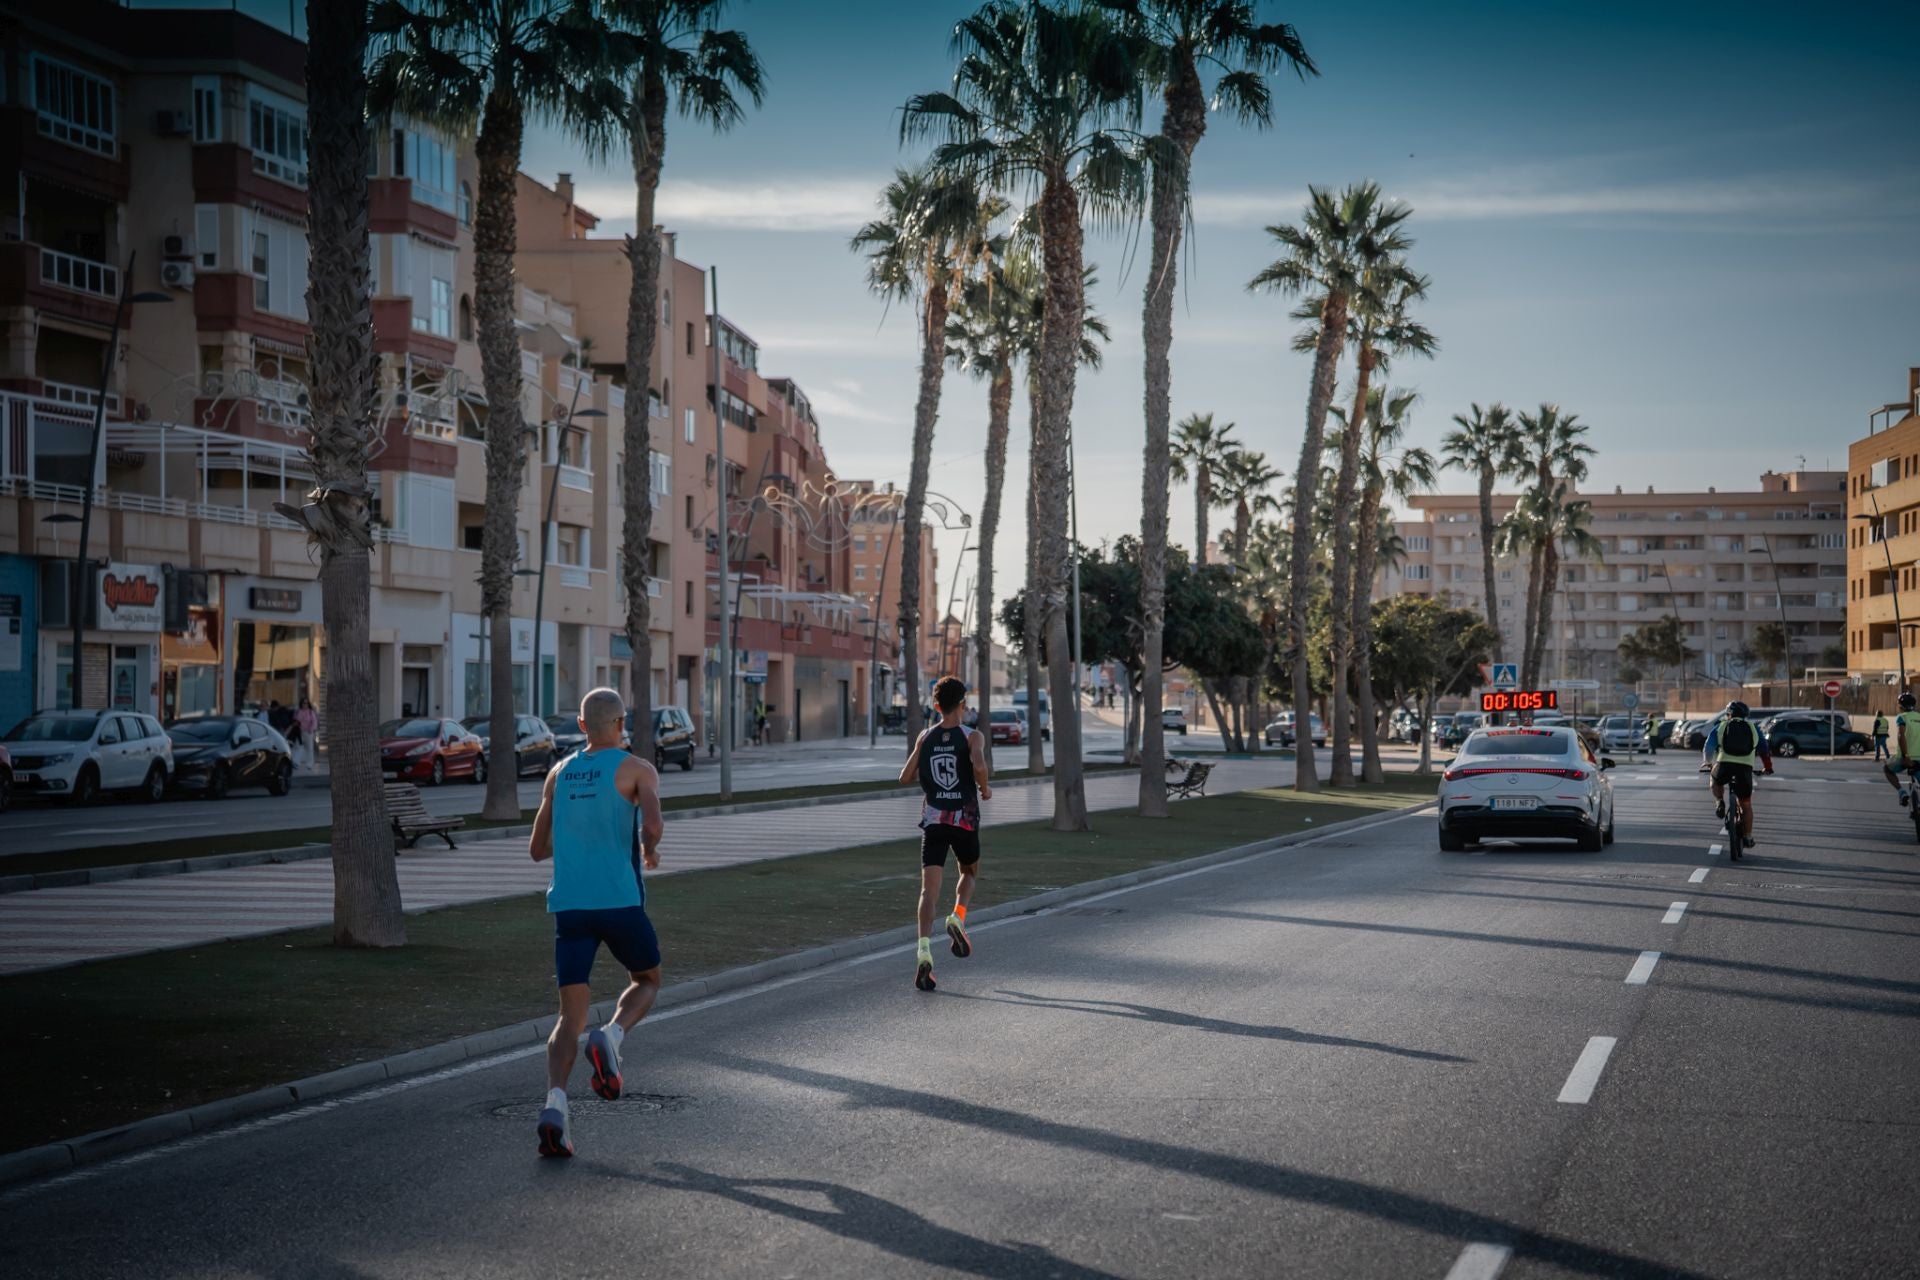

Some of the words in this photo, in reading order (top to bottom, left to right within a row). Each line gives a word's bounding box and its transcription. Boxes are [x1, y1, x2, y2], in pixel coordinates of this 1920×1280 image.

[1483, 692, 1555, 710] 00:10:51
[564, 768, 601, 782] nerja
[1519, 799, 1536, 808] NFZ
